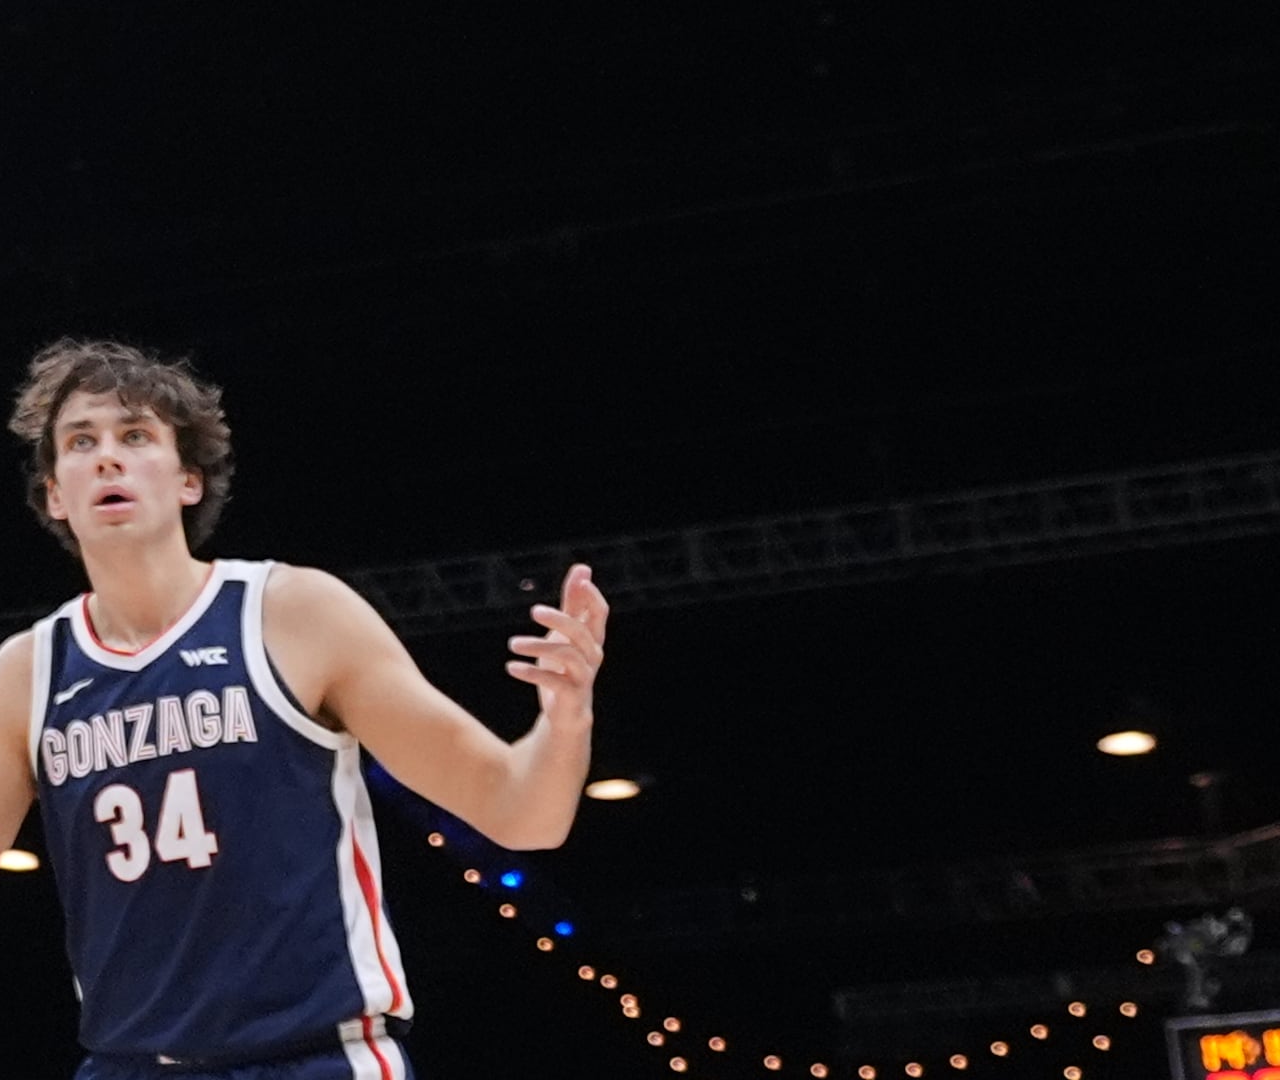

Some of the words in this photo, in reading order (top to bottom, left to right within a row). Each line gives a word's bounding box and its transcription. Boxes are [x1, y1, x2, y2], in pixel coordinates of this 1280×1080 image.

[179, 646, 229, 667] WCC
[42, 685, 258, 787] GONZAGA
[93, 768, 219, 883] 34
